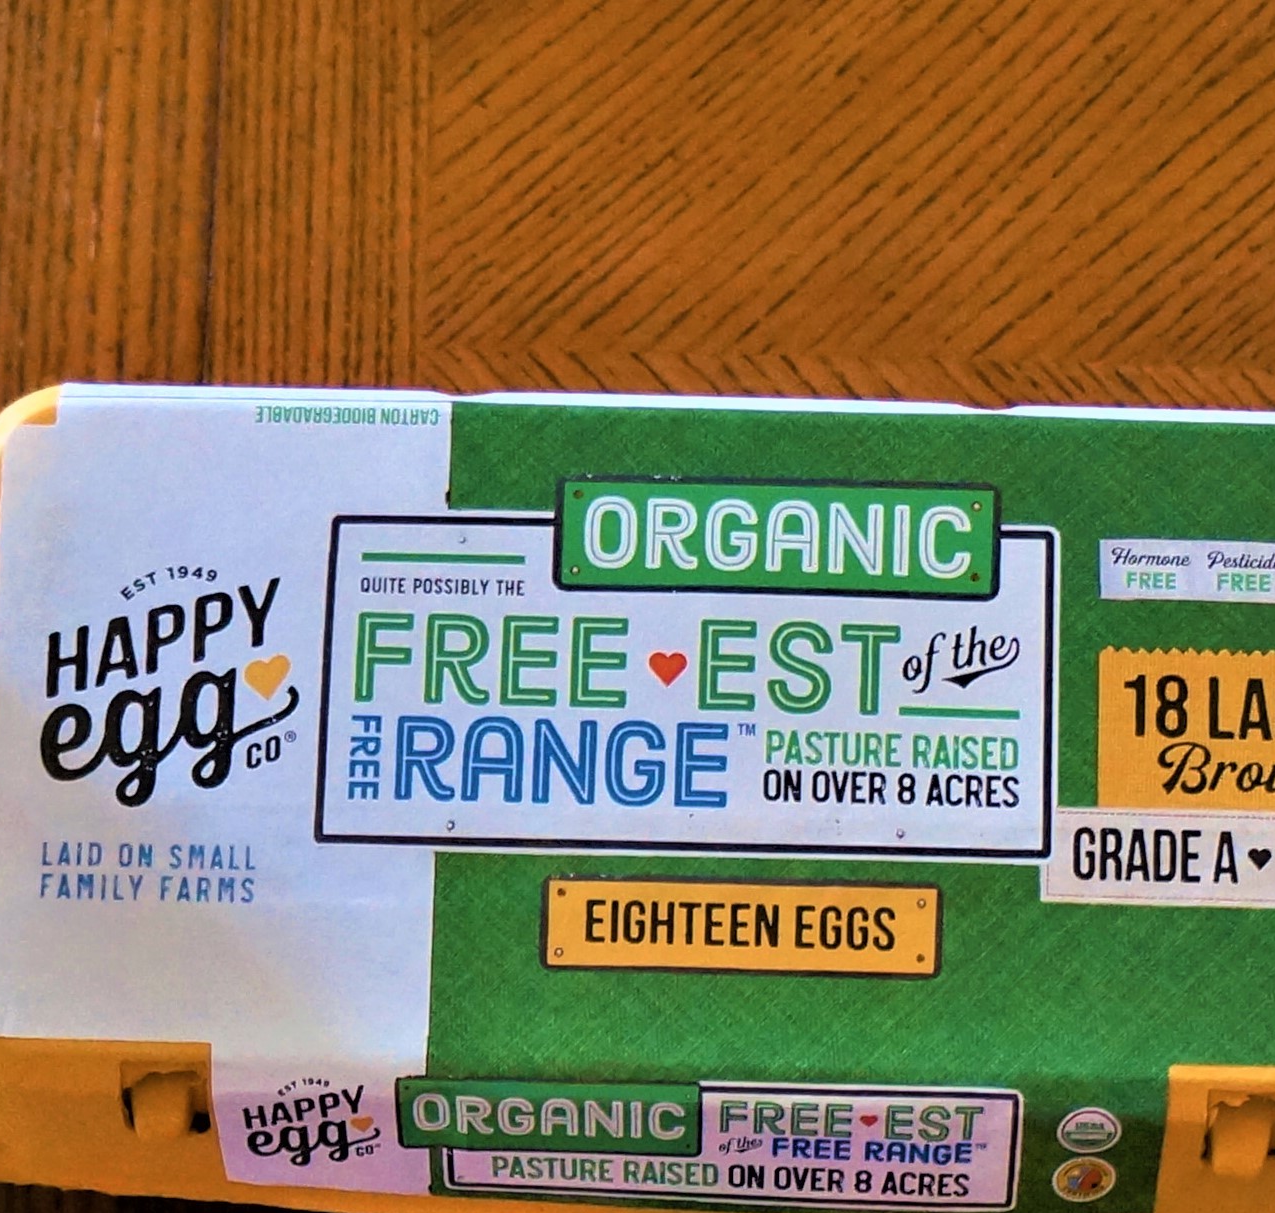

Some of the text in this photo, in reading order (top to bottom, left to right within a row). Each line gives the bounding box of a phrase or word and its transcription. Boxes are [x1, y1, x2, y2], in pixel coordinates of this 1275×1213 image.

[255, 406, 439, 426] CARTON BIODEGRADABLE
[582, 495, 974, 579] ORGANIC
[1111, 546, 1192, 569] Hormone
[167, 565, 218, 584] 1949
[360, 577, 525, 597] QUITE POSSIBLY THE
[1126, 572, 1177, 590] FREE
[1217, 573, 1272, 592] FREE
[46, 577, 281, 698] HAPPY
[353, 610, 901, 716] FREE EST
[1124, 674, 1189, 739] 18
[39, 667, 299, 807] egg
[765, 729, 1020, 771] PASTURE RAISED
[349, 714, 730, 809] FREE RANGE
[763, 770, 1020, 809] ON OVER ACRES
[41, 841, 256, 871] LAID ON SMALL
[1073, 826, 1202, 882] GRADE
[1213, 831, 1239, 884] A
[39, 873, 255, 903] FAMILY FARMS
[584, 898, 897, 952] EIGHTEEN EGGS
[242, 1084, 364, 1129] HAPPY
[413, 1093, 686, 1140] ORGANIC
[718, 1101, 985, 1143] FREE EST
[247, 1119, 380, 1167] egg
[771, 1139, 852, 1161] FREE
[491, 1155, 718, 1187] PASTURE RAISED
[728, 1164, 970, 1197] ON OVER ACRES
